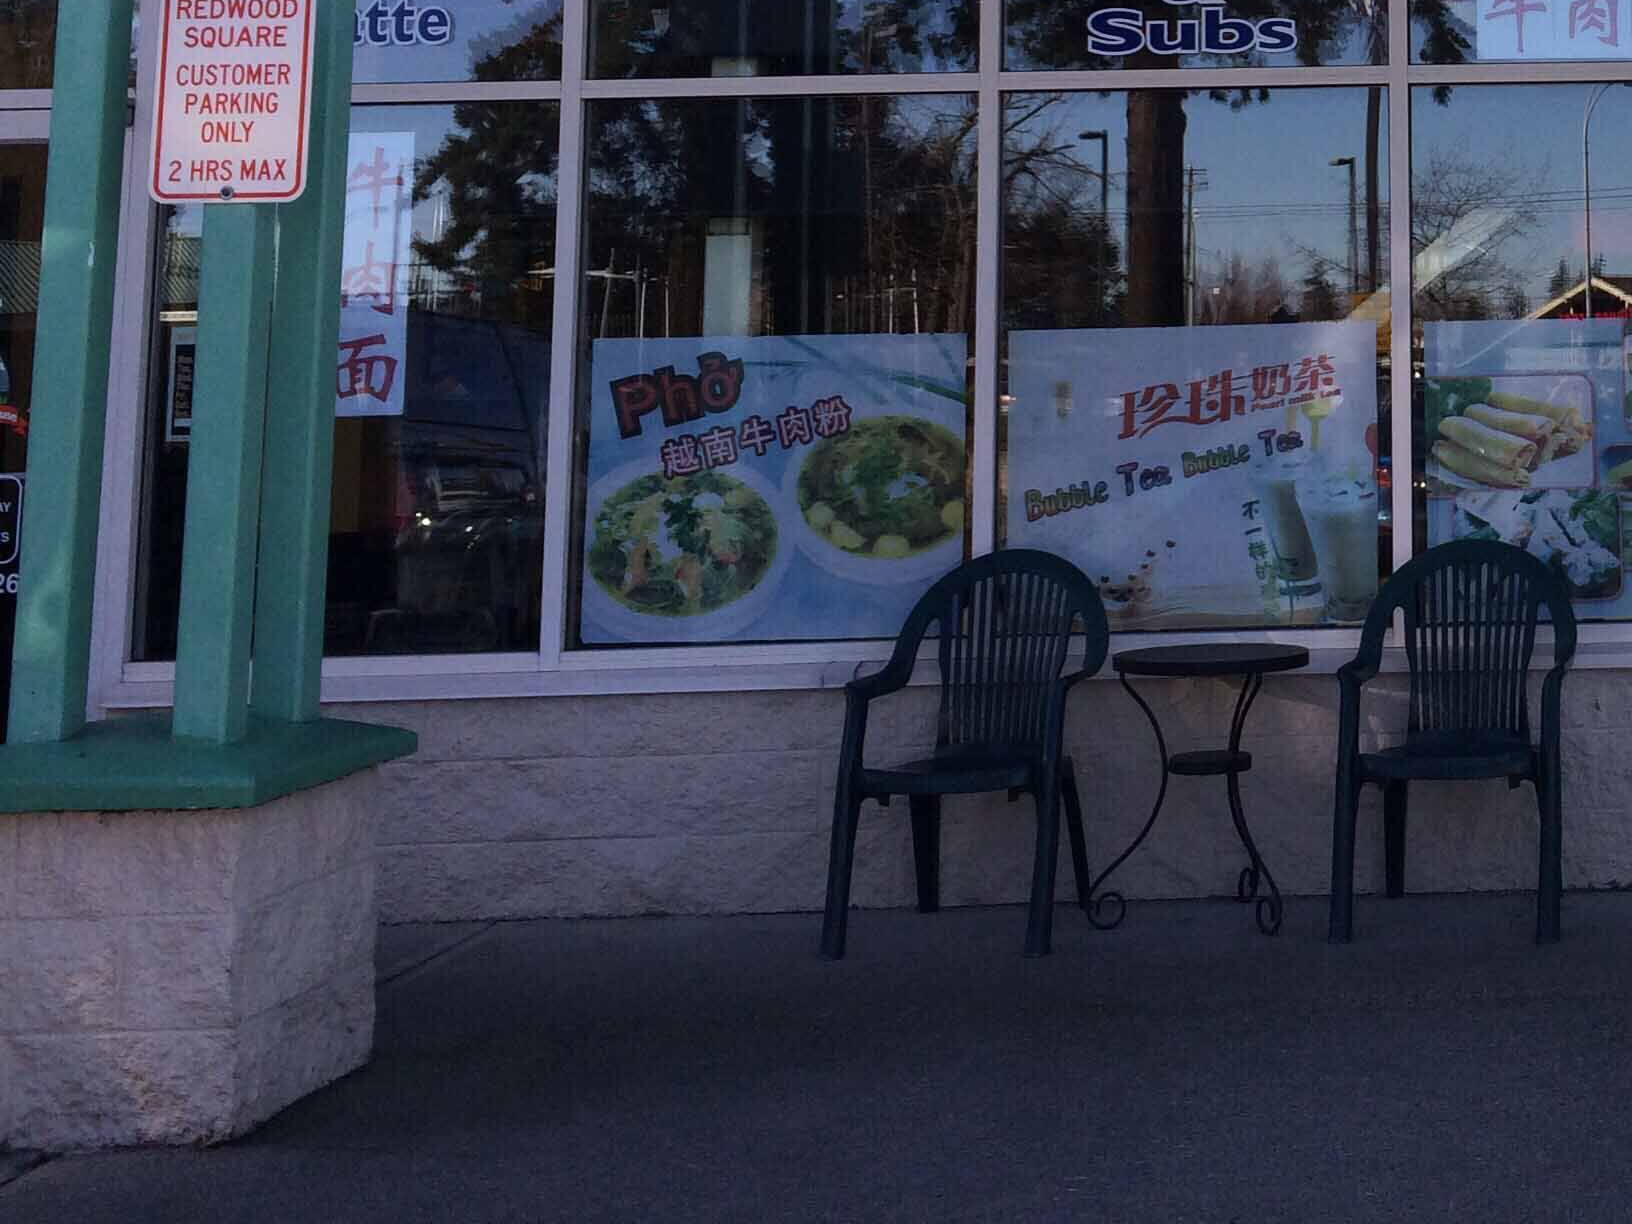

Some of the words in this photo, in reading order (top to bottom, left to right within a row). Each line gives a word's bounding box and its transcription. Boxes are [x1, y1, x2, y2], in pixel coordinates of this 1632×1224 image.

[184, 26, 287, 49] SQUARE
[352, 0, 454, 46] tte
[1087, 6, 1297, 56] Subs
[176, 63, 291, 86] CUSTOMER
[184, 93, 279, 115] PARKING
[200, 121, 254, 144] ONLY
[168, 161, 182, 182] 2
[189, 161, 233, 182] HRS
[240, 159, 286, 181] MAX
[1117, 353, 1338, 440] 珍珠奶茶
[661, 395, 852, 479] 越南牛肉粉
[1025, 479, 1109, 522] Bubble
[1117, 462, 1173, 497] Tea
[1181, 443, 1251, 478] Bubble
[1258, 429, 1304, 457] Tea
